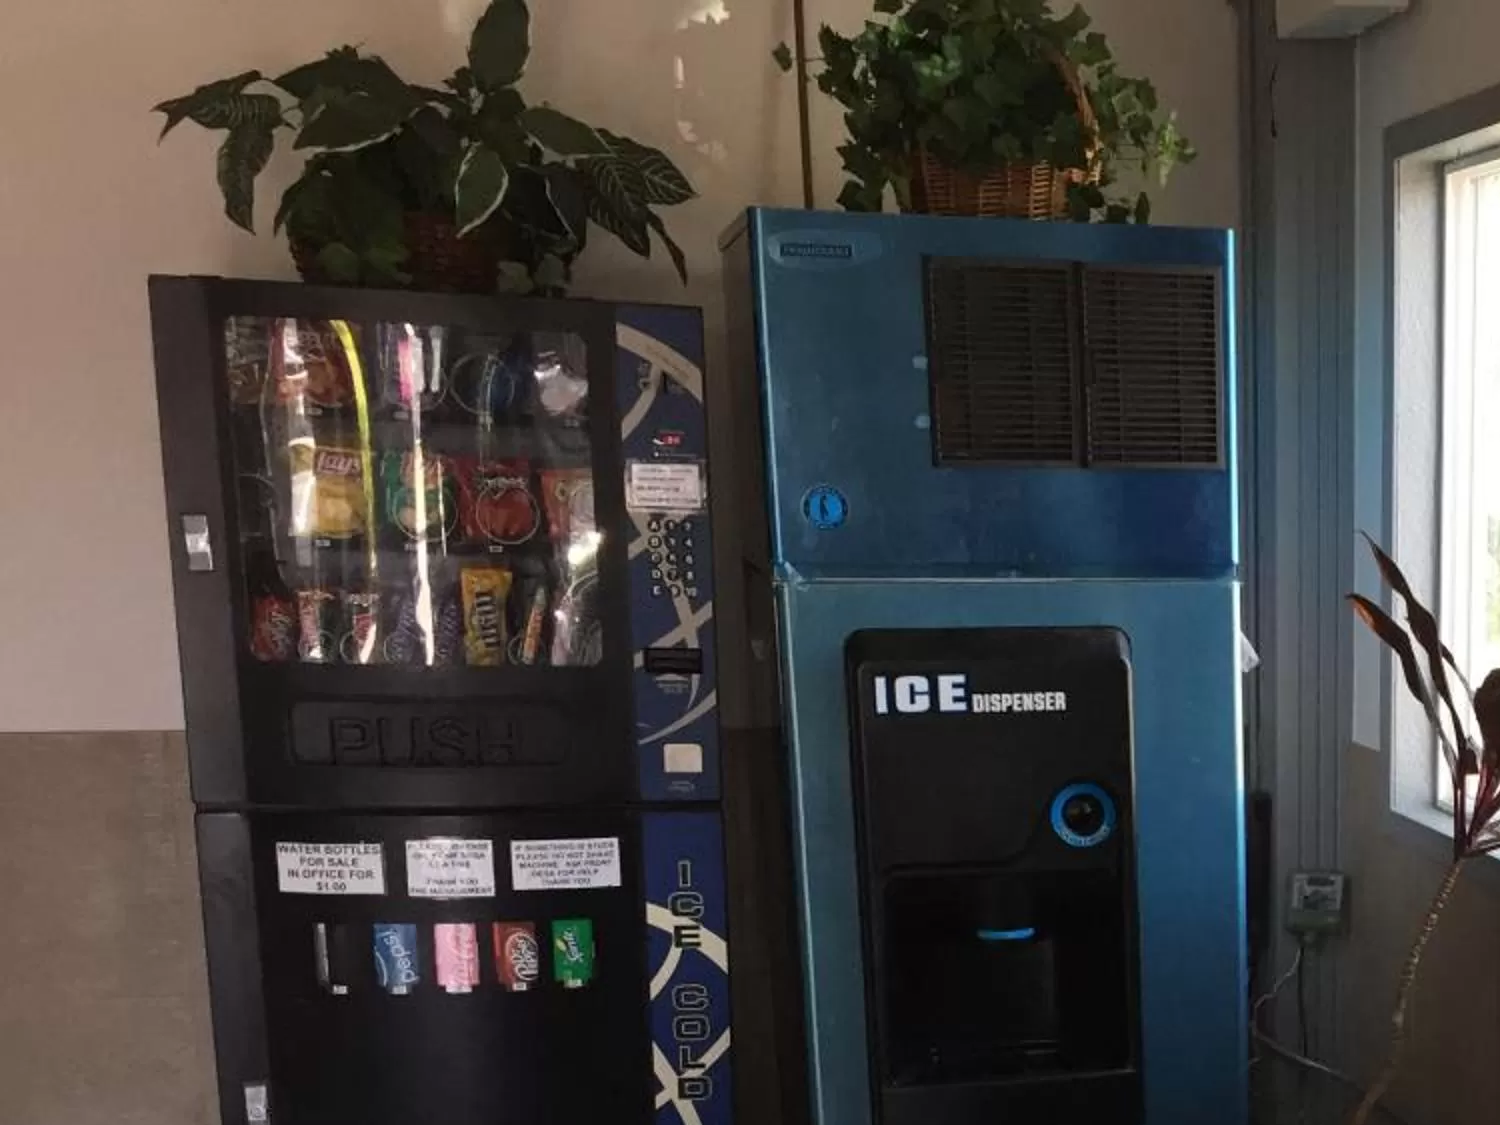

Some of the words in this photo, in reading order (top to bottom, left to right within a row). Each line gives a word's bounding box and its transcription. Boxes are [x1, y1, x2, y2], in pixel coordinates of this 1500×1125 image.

[874, 674, 968, 714] ICE
[972, 691, 1067, 713] DISPENSER
[327, 715, 522, 768] PUSH
[277, 844, 322, 855] WATER
[324, 844, 380, 855] BOTTLES
[300, 857, 325, 867] FOR
[327, 857, 359, 867] SALE
[287, 869, 299, 878] IN
[301, 869, 346, 879] OFFICE
[350, 869, 374, 879] FOR
[316, 881, 347, 891] $1.00
[667, 860, 705, 949] ICE
[672, 983, 712, 1100] COLD
